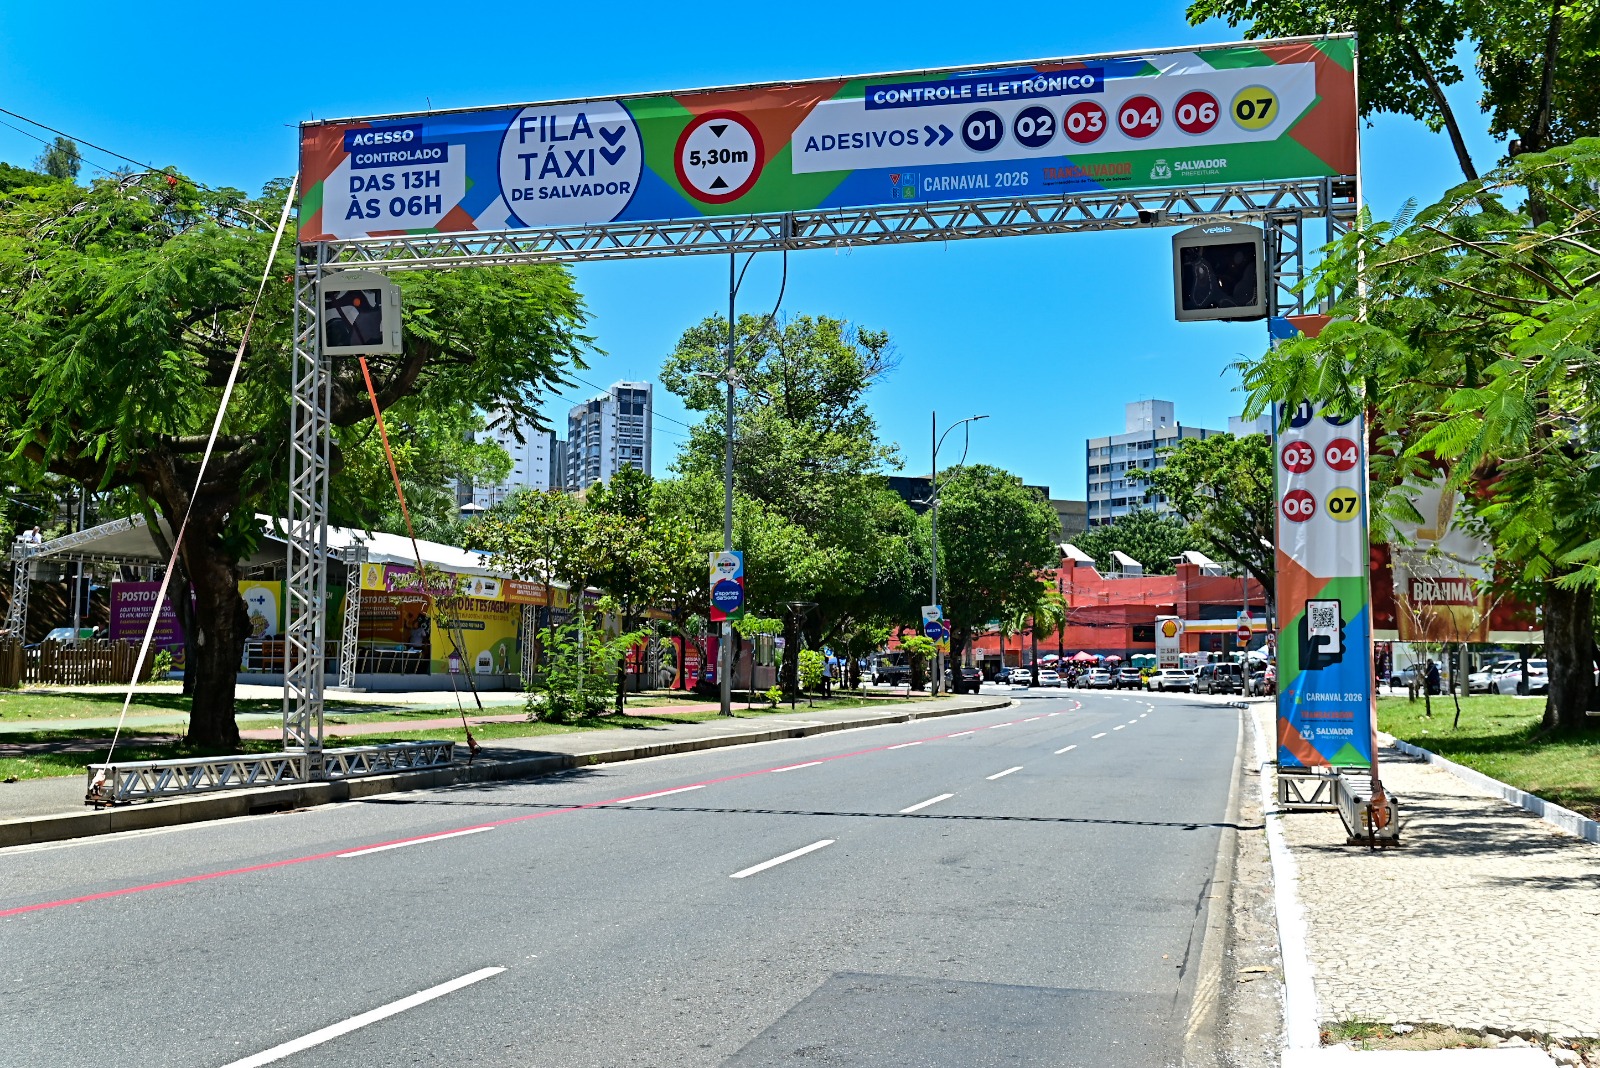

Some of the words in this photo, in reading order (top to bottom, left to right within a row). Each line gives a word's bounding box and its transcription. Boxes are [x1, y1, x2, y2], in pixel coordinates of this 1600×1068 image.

[873, 83, 972, 104] CONTROLE
[976, 74, 1095, 97] ELETRÔNICO
[519, 112, 594, 145] FILA
[805, 129, 919, 152] ADESIVOS
[967, 118, 997, 141] 01
[1016, 115, 1053, 138] 02
[1067, 111, 1103, 134] 03
[1120, 106, 1160, 130] 04
[1177, 102, 1217, 125] 06
[1235, 97, 1273, 121] 07
[352, 129, 414, 146] ACESSO
[355, 148, 442, 165] CONTROLADO
[518, 145, 595, 181] TÁXI
[689, 148, 749, 169] 5,30m
[1174, 158, 1227, 171] SALVADOR
[350, 172, 396, 193] DAS
[401, 169, 440, 190] 13H
[1043, 162, 1132, 180] TRANSALVADOR
[1181, 169, 1220, 177] PREFEITURA
[512, 187, 534, 201] DE
[538, 181, 631, 199] SALVADOR
[923, 174, 991, 192] CARNAVAL
[994, 171, 1029, 188] 2026
[345, 195, 381, 220] ÀS
[389, 195, 442, 217] 06H
[1284, 448, 1313, 466] 03
[1326, 446, 1357, 464] 04
[1284, 498, 1314, 516] 06
[1329, 497, 1357, 514] 07
[121, 591, 151, 602] POSTO
[1413, 582, 1474, 602] BRAHMA
[465, 598, 474, 610] DE
[475, 599, 510, 613] TESTAGEM
[1306, 692, 1343, 702] CARNAVAL
[1343, 693, 1363, 702] 2026
[1315, 727, 1354, 736] SALVADOR
